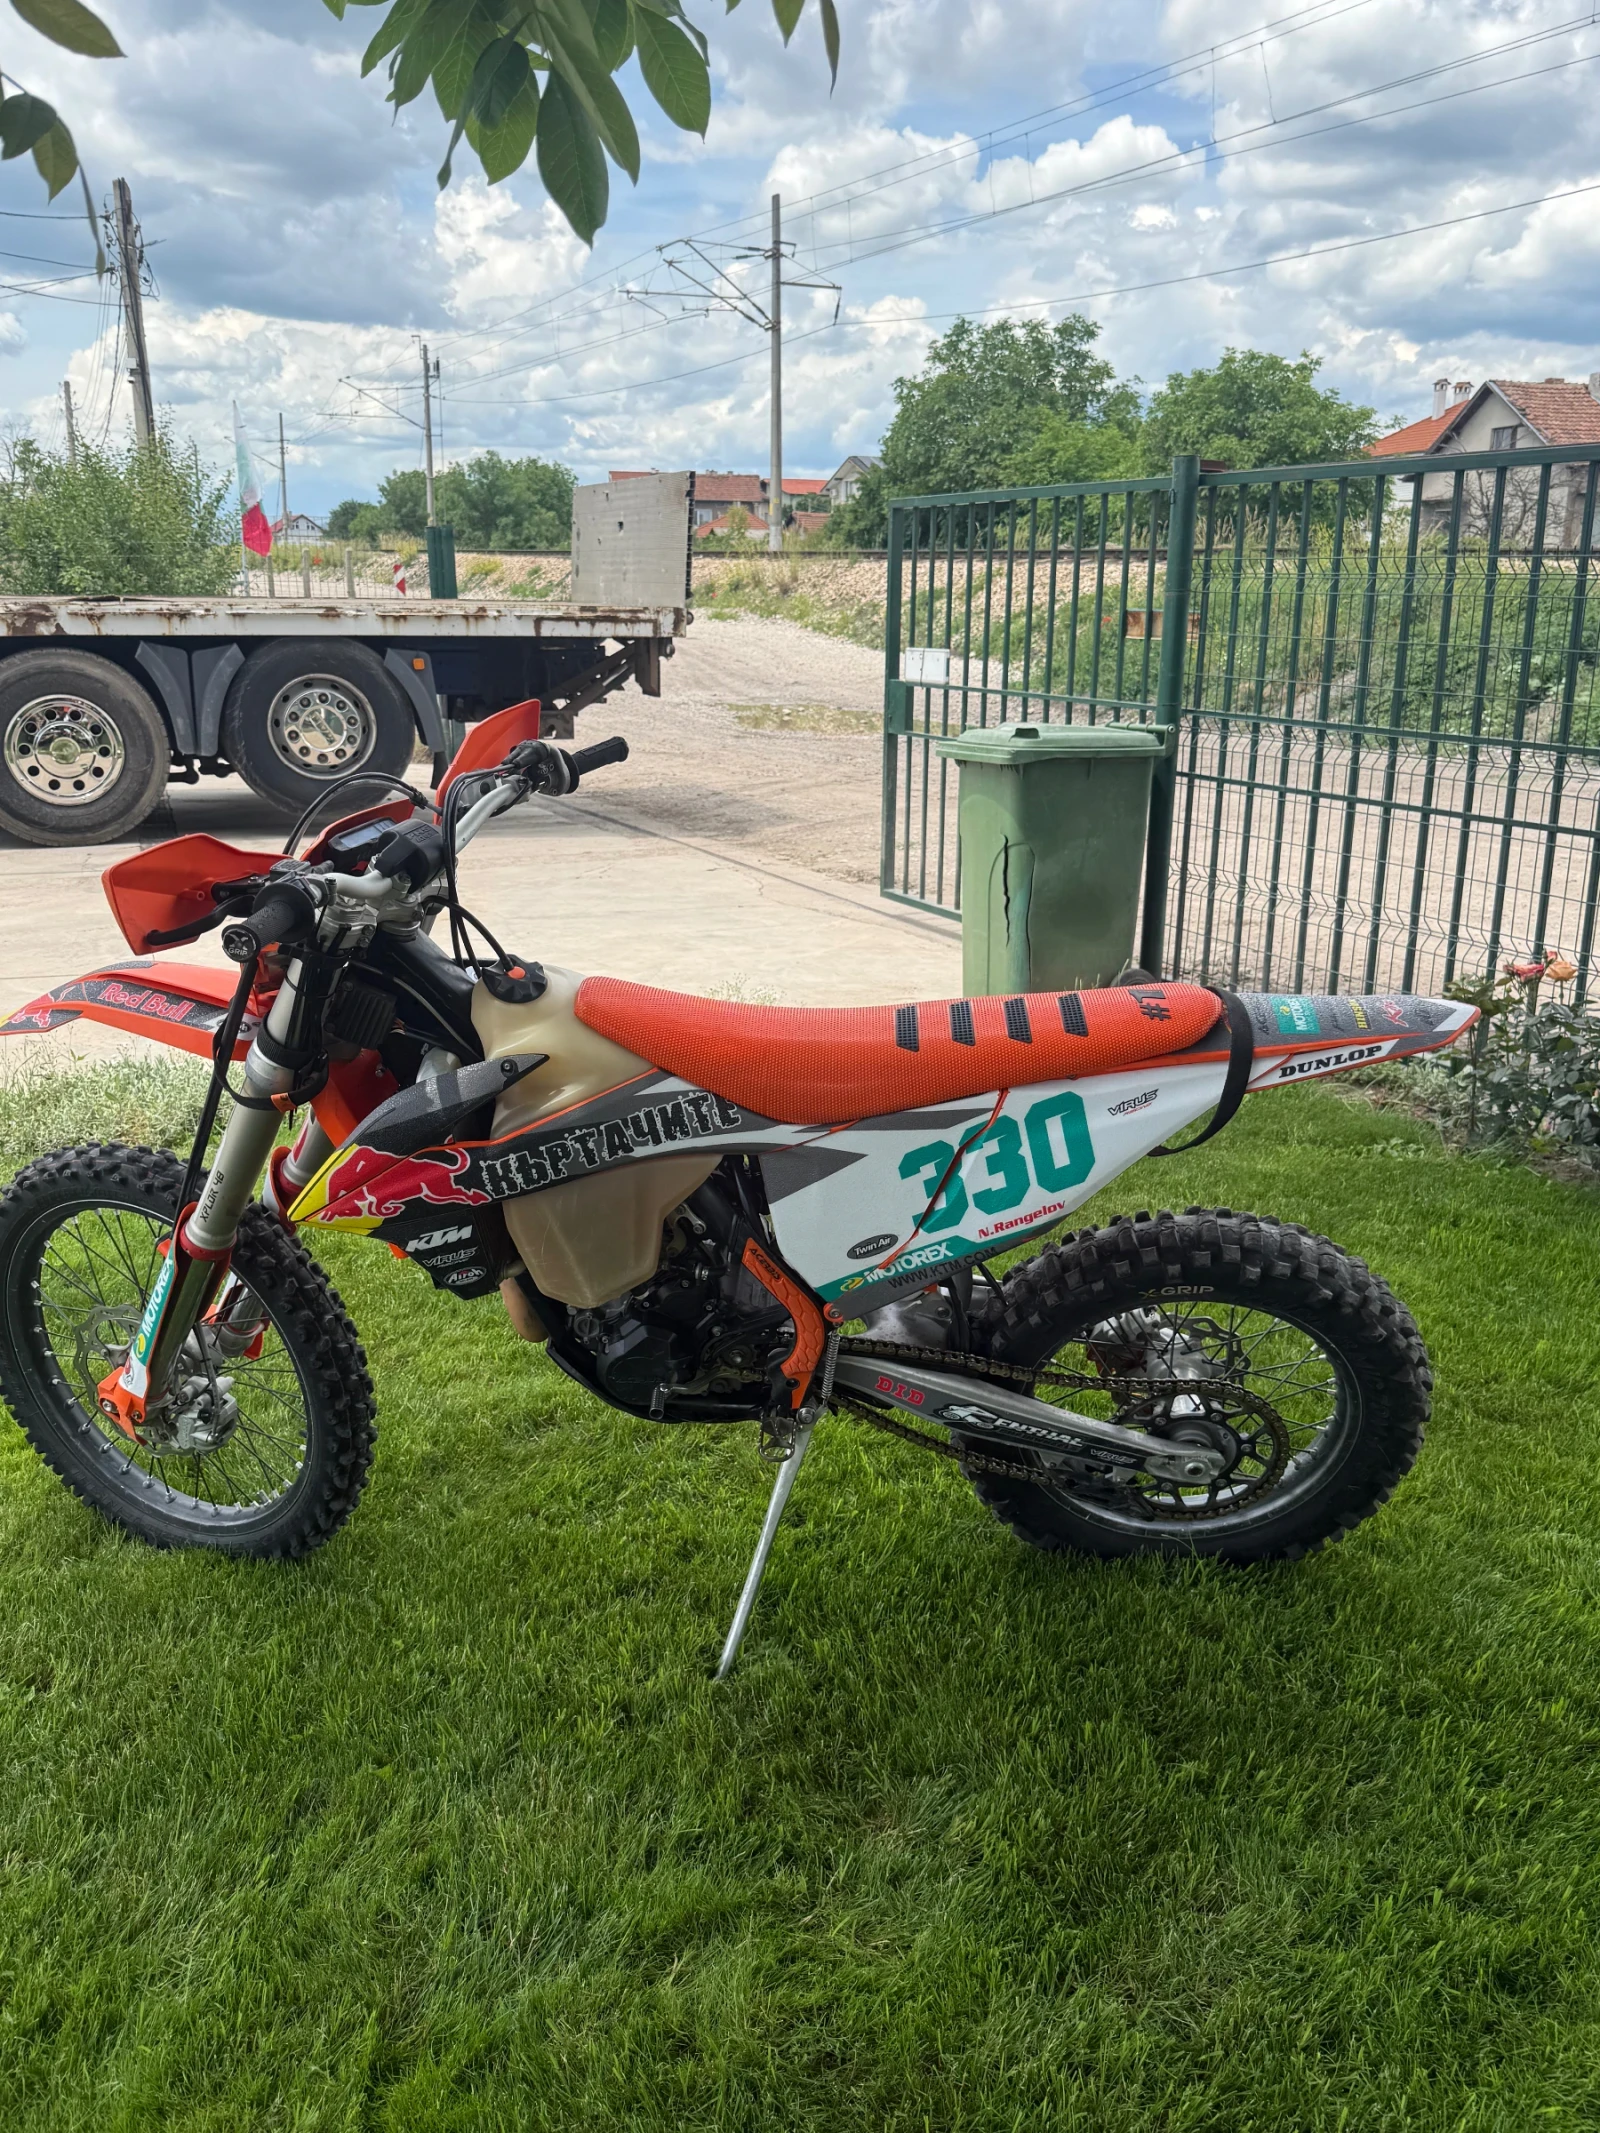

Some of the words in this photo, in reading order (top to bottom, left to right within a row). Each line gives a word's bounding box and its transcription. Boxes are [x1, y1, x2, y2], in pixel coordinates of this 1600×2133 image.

[229, 948, 248, 956] GRIP
[99, 982, 150, 1010] Red
[142, 993, 196, 1022] Bull
[1279, 1045, 1382, 1079] DUNLOP
[1107, 1088, 1159, 1116] VIRUS
[898, 1090, 1096, 1234] 330
[200, 1188, 219, 1223] XPLOR
[213, 1170, 225, 1186] 48
[978, 1201, 1065, 1238] N.Rangelov
[405, 1225, 473, 1252] KTM
[854, 1243, 877, 1256] Twin
[877, 1236, 892, 1248] Air
[422, 1246, 478, 1267] VIRUS
[864, 1241, 954, 1282] MOTOREX
[888, 1246, 998, 1288] WWW.KTM.COM
[447, 1268, 484, 1284] Airoh
[142, 1257, 174, 1334] MOTOREX
